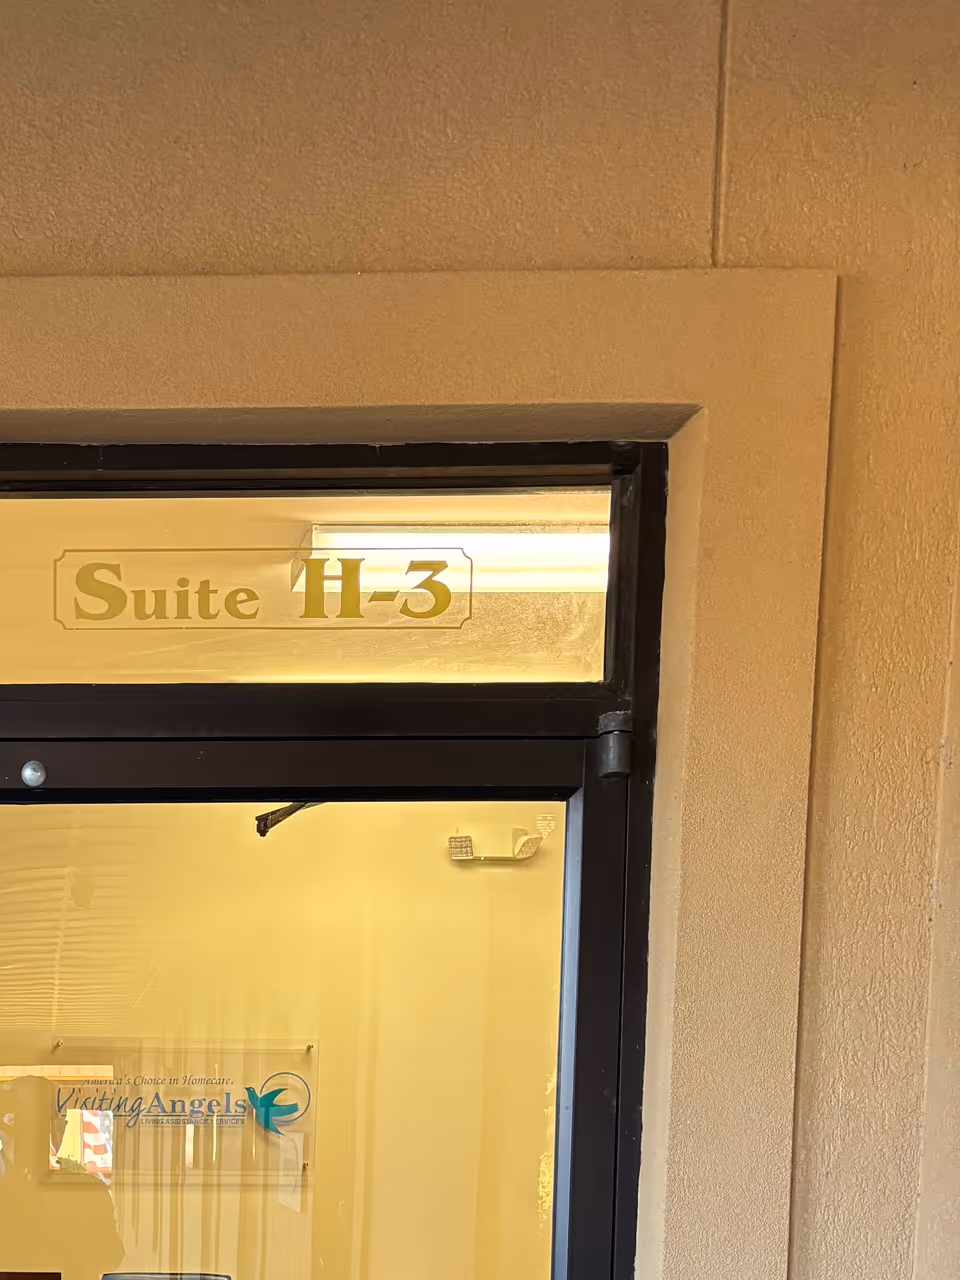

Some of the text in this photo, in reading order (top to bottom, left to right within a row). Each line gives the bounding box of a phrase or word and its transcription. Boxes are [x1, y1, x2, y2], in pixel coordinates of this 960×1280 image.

[74, 557, 453, 620] Suite H-3
[133, 1074, 166, 1087] Choice
[169, 1076, 179, 1086] in
